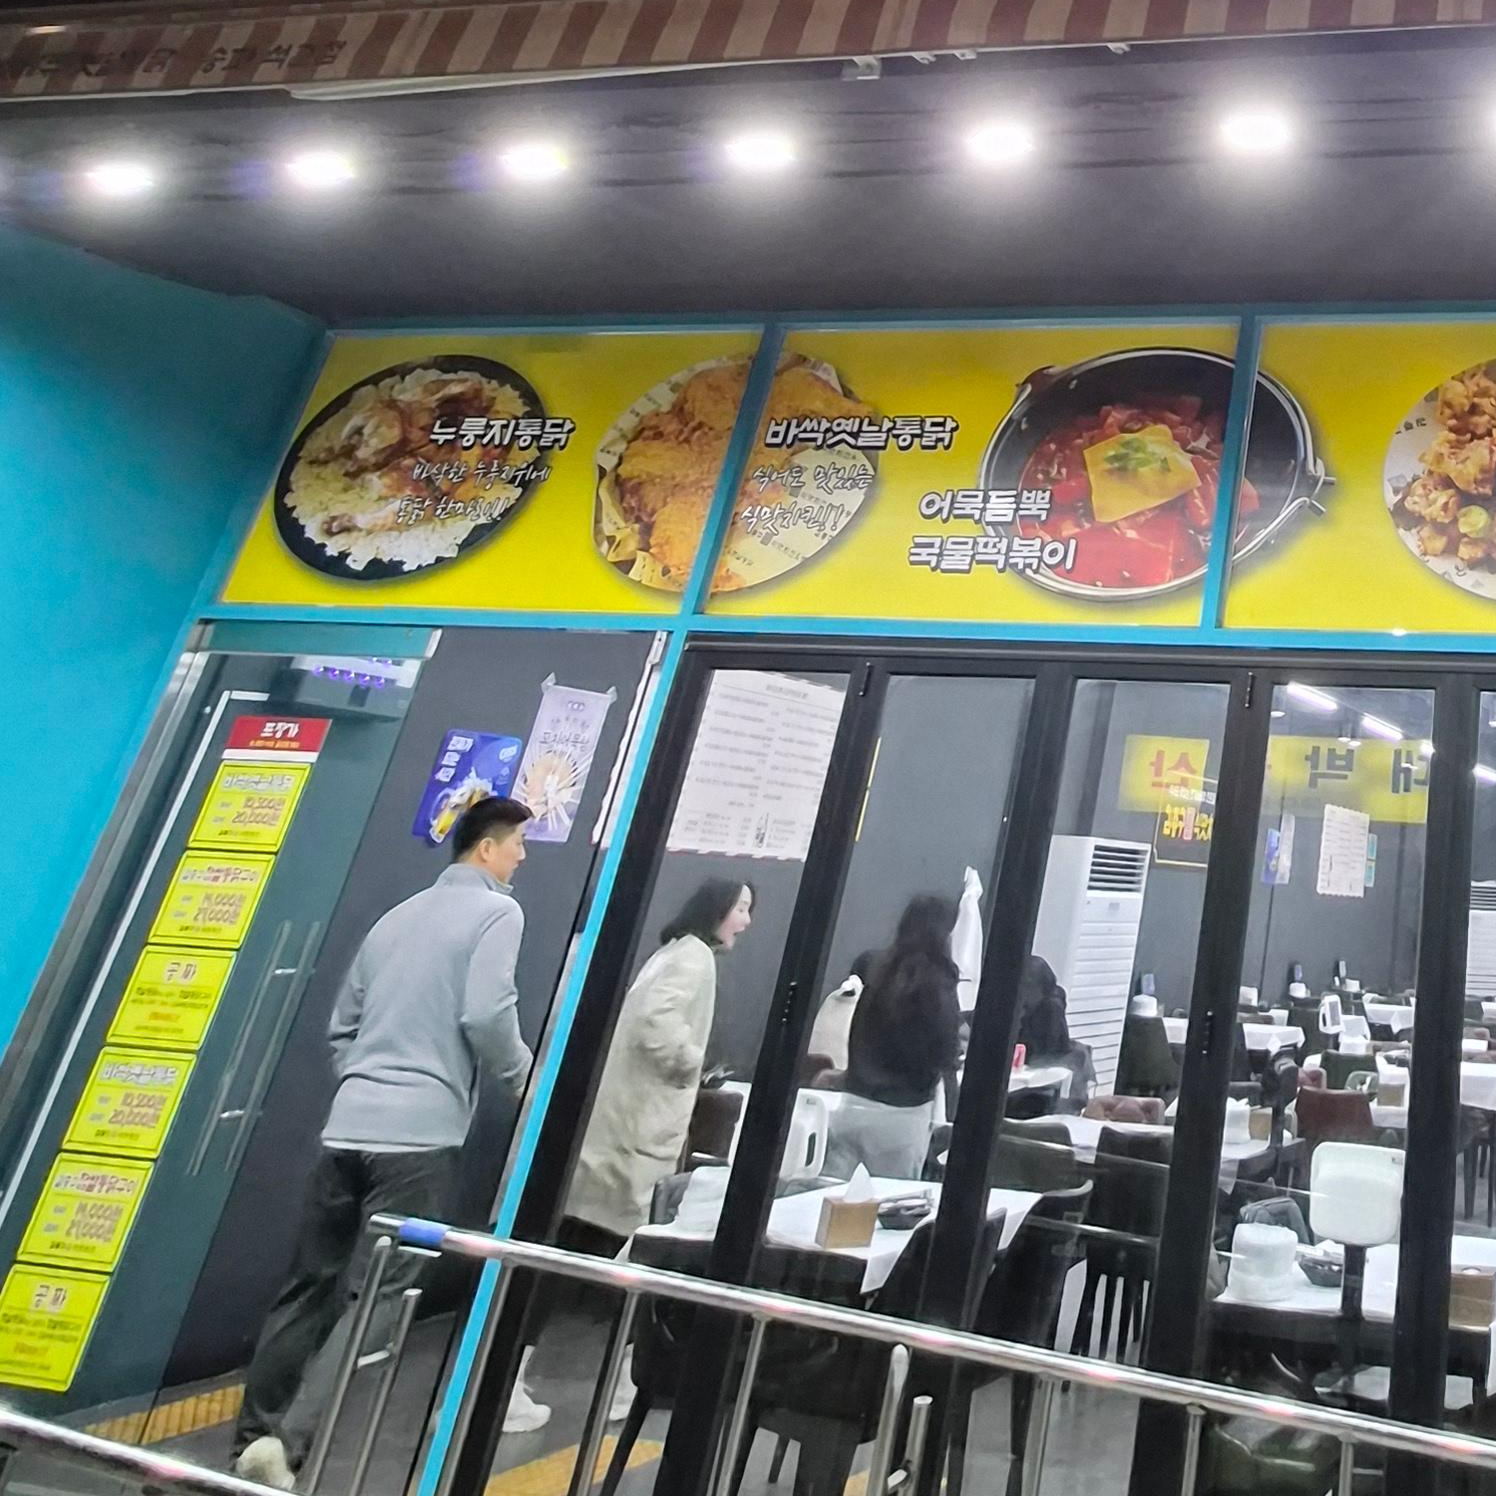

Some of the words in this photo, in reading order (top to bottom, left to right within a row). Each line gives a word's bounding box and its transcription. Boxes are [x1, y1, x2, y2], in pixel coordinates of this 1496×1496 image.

[428, 416, 576, 451] 누룽지통닭
[764, 415, 959, 453] 바싹옛날통닭
[753, 464, 807, 494] 식어도
[813, 461, 877, 494] 맛있는
[918, 488, 1054, 523] 어묵듬뿍
[908, 535, 1078, 573] 국물떡볶이
